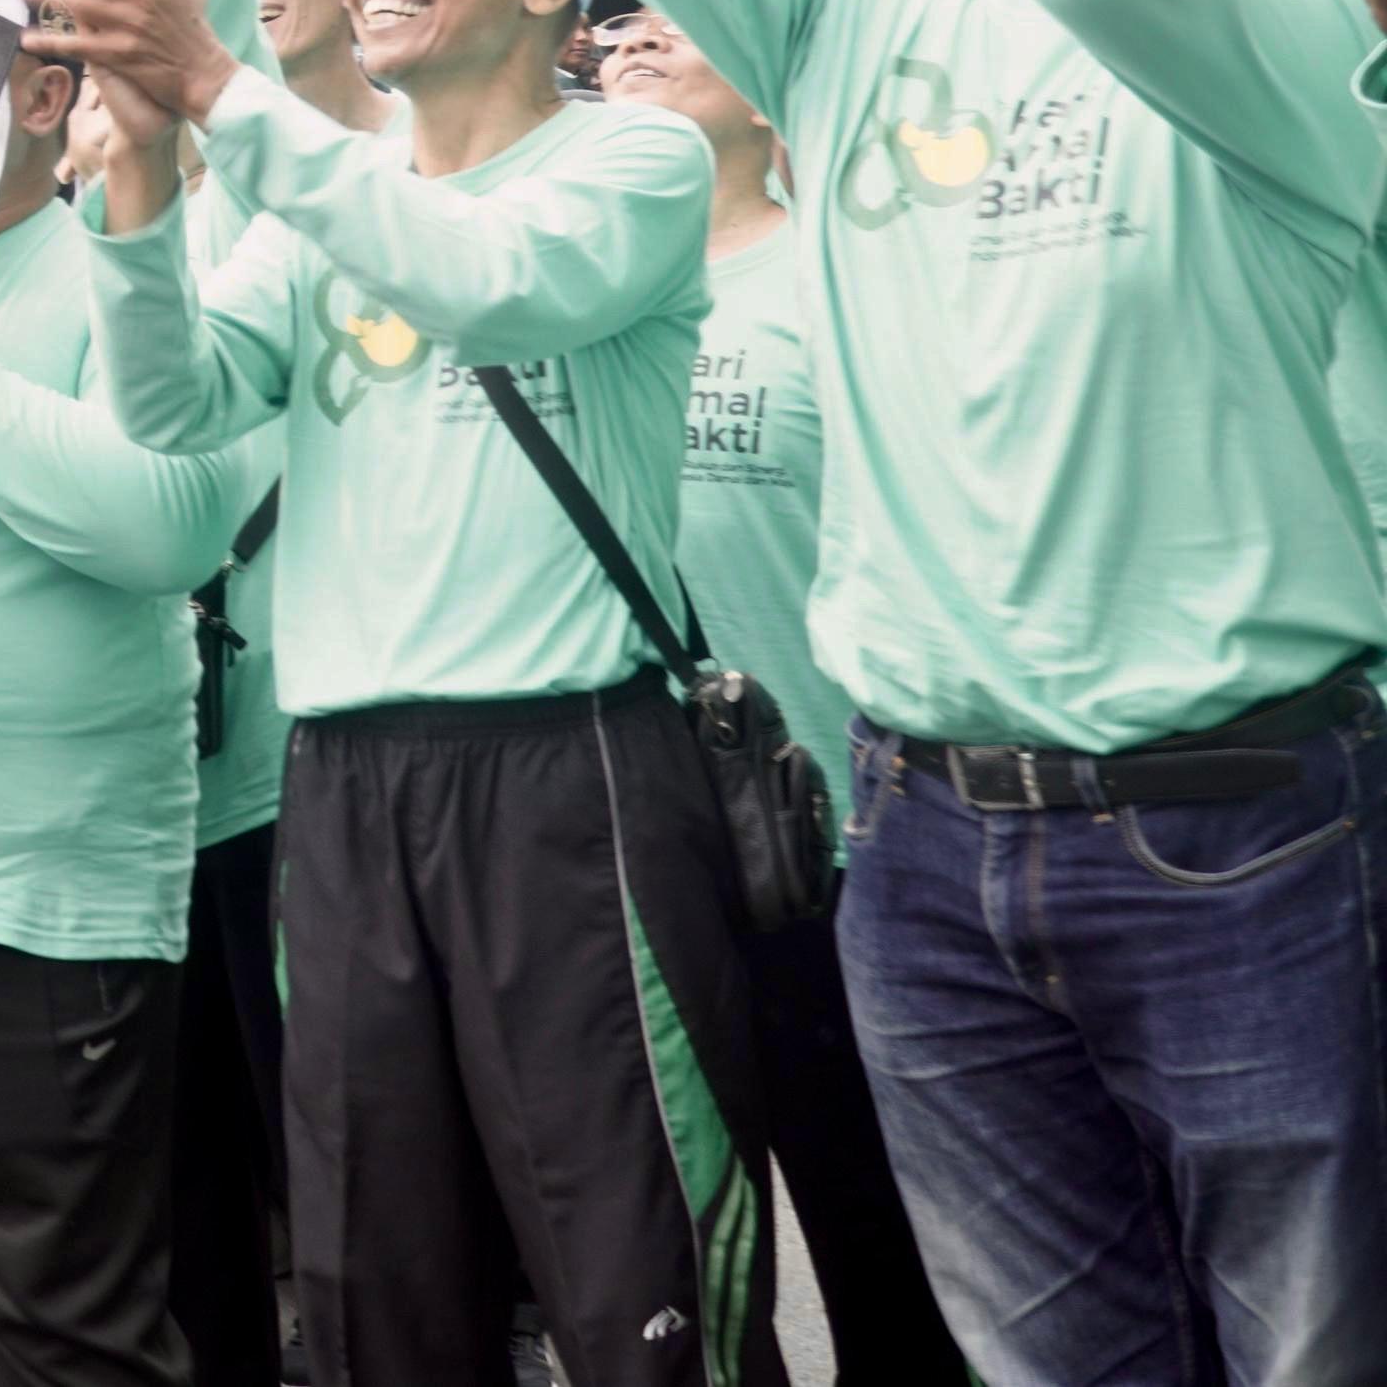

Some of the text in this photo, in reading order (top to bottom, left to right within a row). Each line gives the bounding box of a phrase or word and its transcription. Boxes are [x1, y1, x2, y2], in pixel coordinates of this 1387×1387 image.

[691, 349, 747, 380] ari
[687, 386, 768, 419] mal
[684, 417, 762, 455] akti
